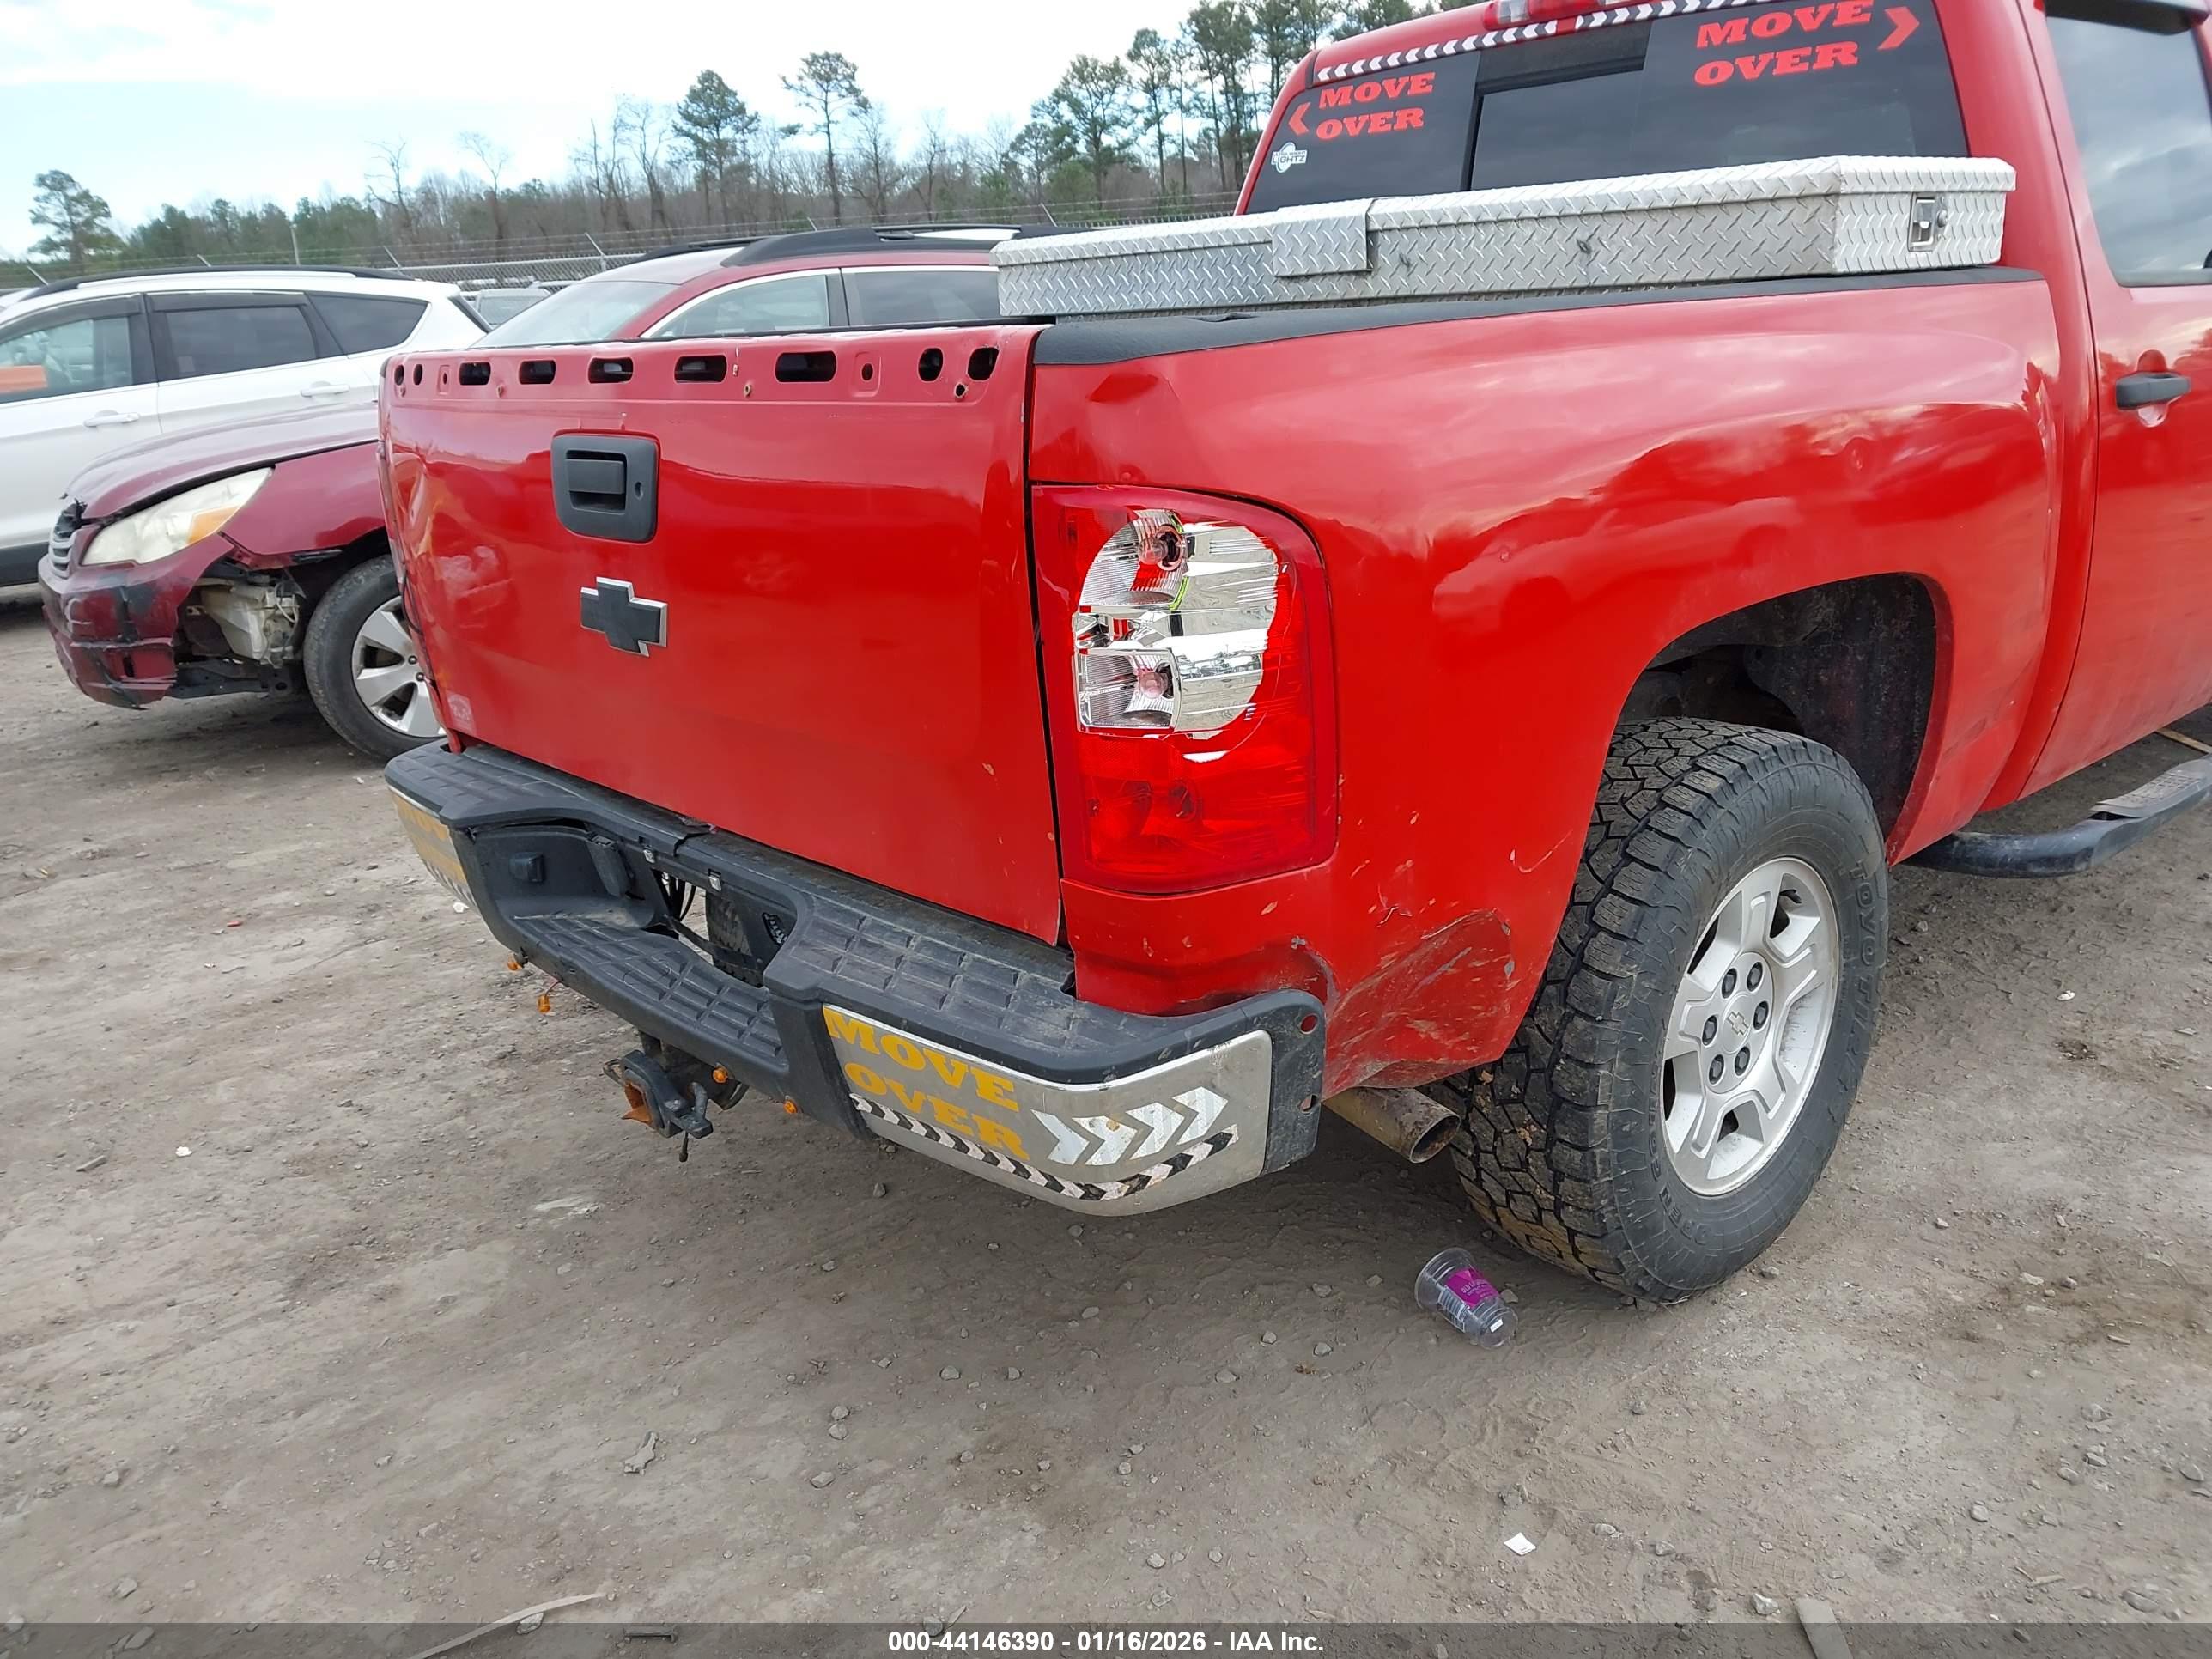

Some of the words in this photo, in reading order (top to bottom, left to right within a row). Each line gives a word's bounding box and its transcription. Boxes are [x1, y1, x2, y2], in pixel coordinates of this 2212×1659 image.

[1696, 0, 1875, 49] MOVE
[1693, 40, 1859, 86] OVER
[1318, 71, 1436, 109] MOVE
[1316, 107, 1425, 140] OVER
[823, 1006, 1020, 1113] MOVE
[844, 1062, 1030, 1161] OVER
